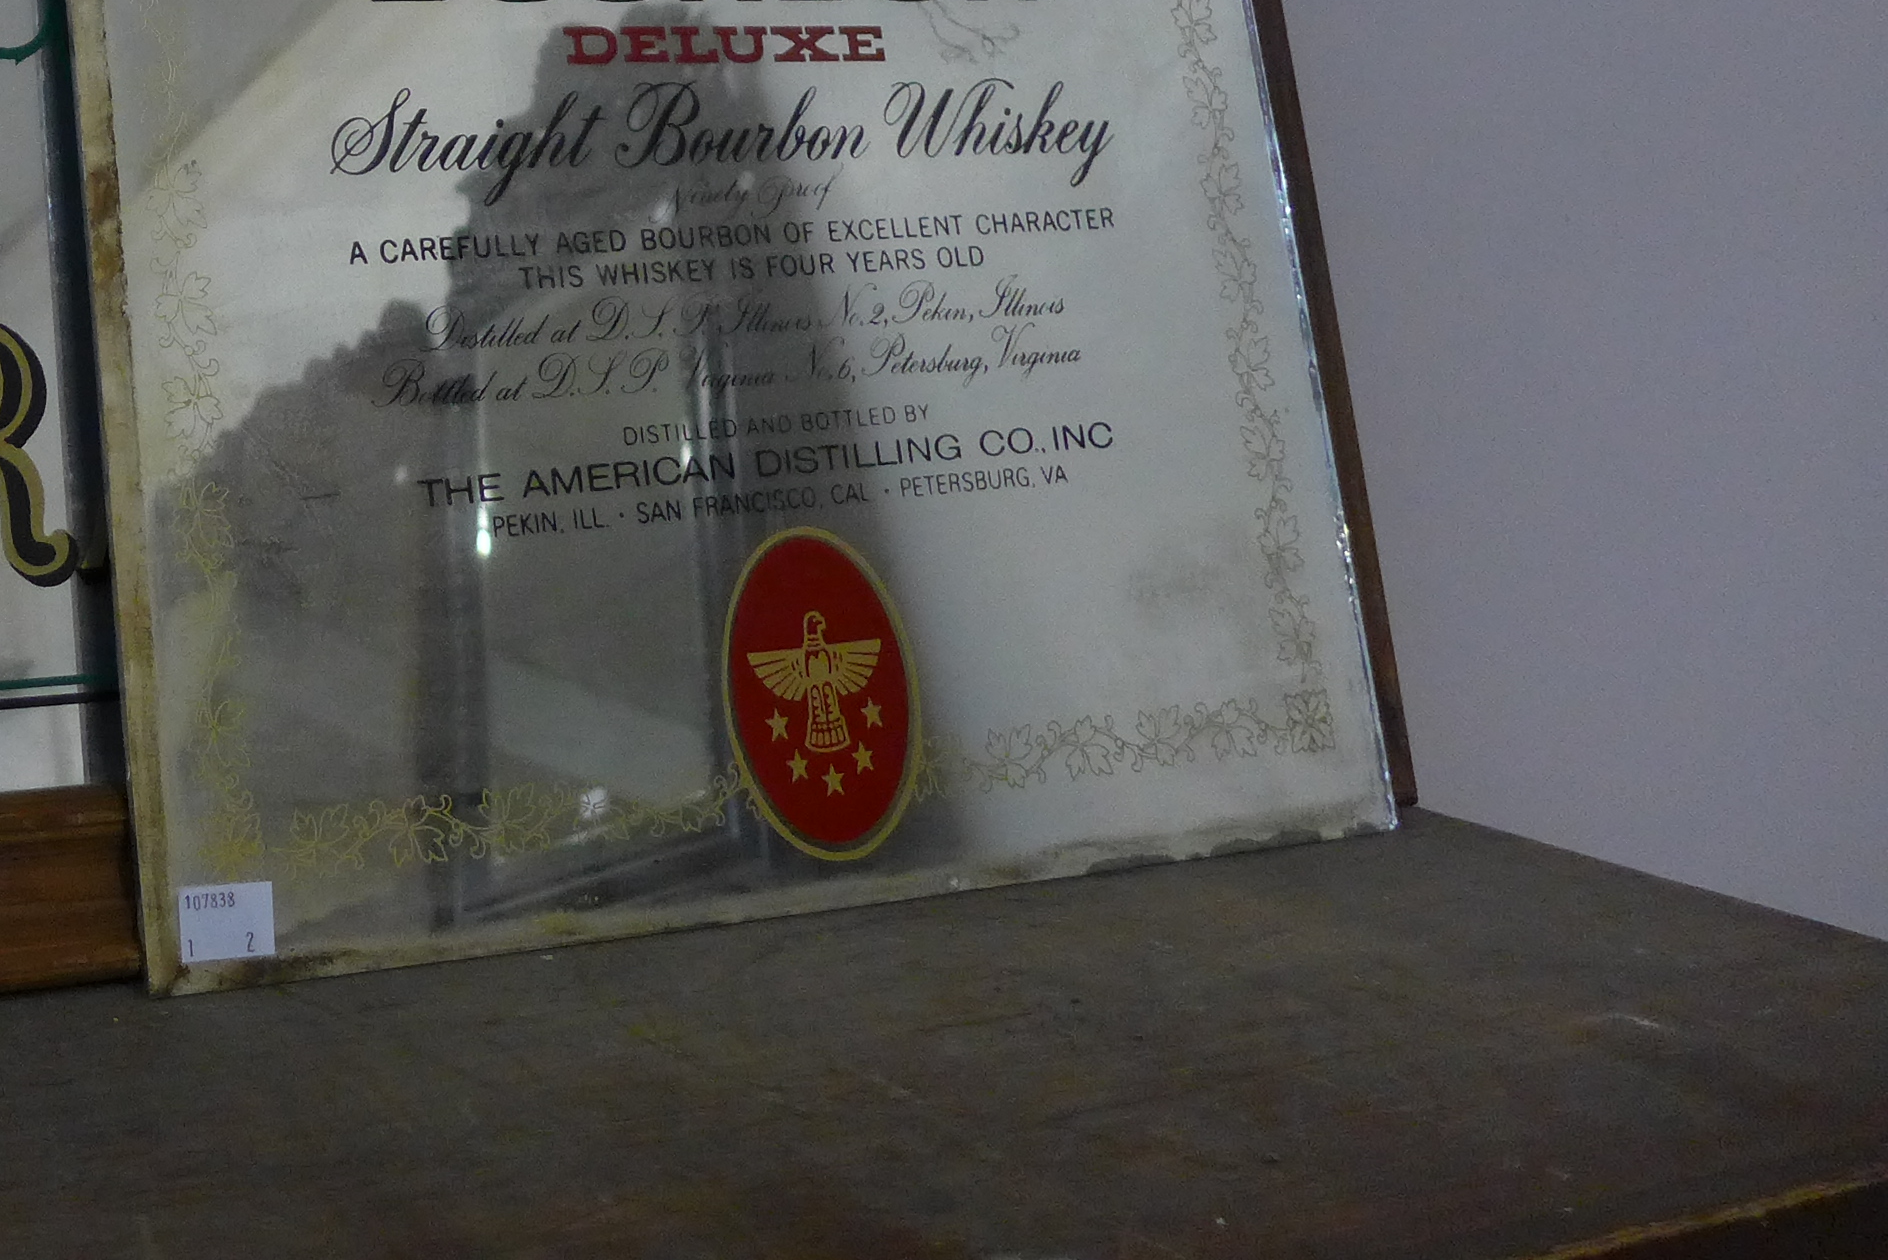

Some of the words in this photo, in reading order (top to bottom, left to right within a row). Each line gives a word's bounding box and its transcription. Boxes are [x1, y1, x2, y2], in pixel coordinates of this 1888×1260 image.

[563, 24, 886, 65] DELUXE
[330, 87, 608, 206] Straight
[614, 80, 870, 169] Bourbon
[884, 78, 1113, 187] Whiskey
[350, 241, 368, 265] A
[380, 233, 540, 265] CAREFULLY
[557, 229, 627, 255] AGED
[641, 223, 772, 251] BOURBON
[783, 221, 814, 244] OF
[829, 214, 963, 242] EXCELLENT
[976, 207, 1115, 235] CHARACTER
[518, 265, 584, 290] THIS
[596, 258, 715, 287] WHISKEY
[731, 256, 755, 280] IS
[767, 253, 835, 278] FOUR
[847, 248, 927, 274] YEARS
[937, 245, 985, 269] OLD
[419, 304, 550, 352] Distilled
[550, 319, 582, 345] at
[979, 274, 1066, 319] Illinois
[371, 358, 498, 408] Bottled
[495, 376, 529, 403] at
[991, 322, 1082, 379] Virginia
[623, 419, 737, 446] DISTILLED
[747, 414, 792, 435] AND
[802, 406, 896, 432] BOTTLED
[905, 403, 930, 424] BY
[417, 473, 505, 507] THE
[523, 453, 735, 499] AMERICAN
[756, 434, 962, 478] DISTILLING
[636, 501, 682, 524] SAN
[900, 467, 1035, 497] PETERSBURG,
[1040, 465, 1069, 484] VA
[184, 891, 235, 911] 107838
[187, 939, 194, 957] 1
[246, 932, 255, 953] 2
